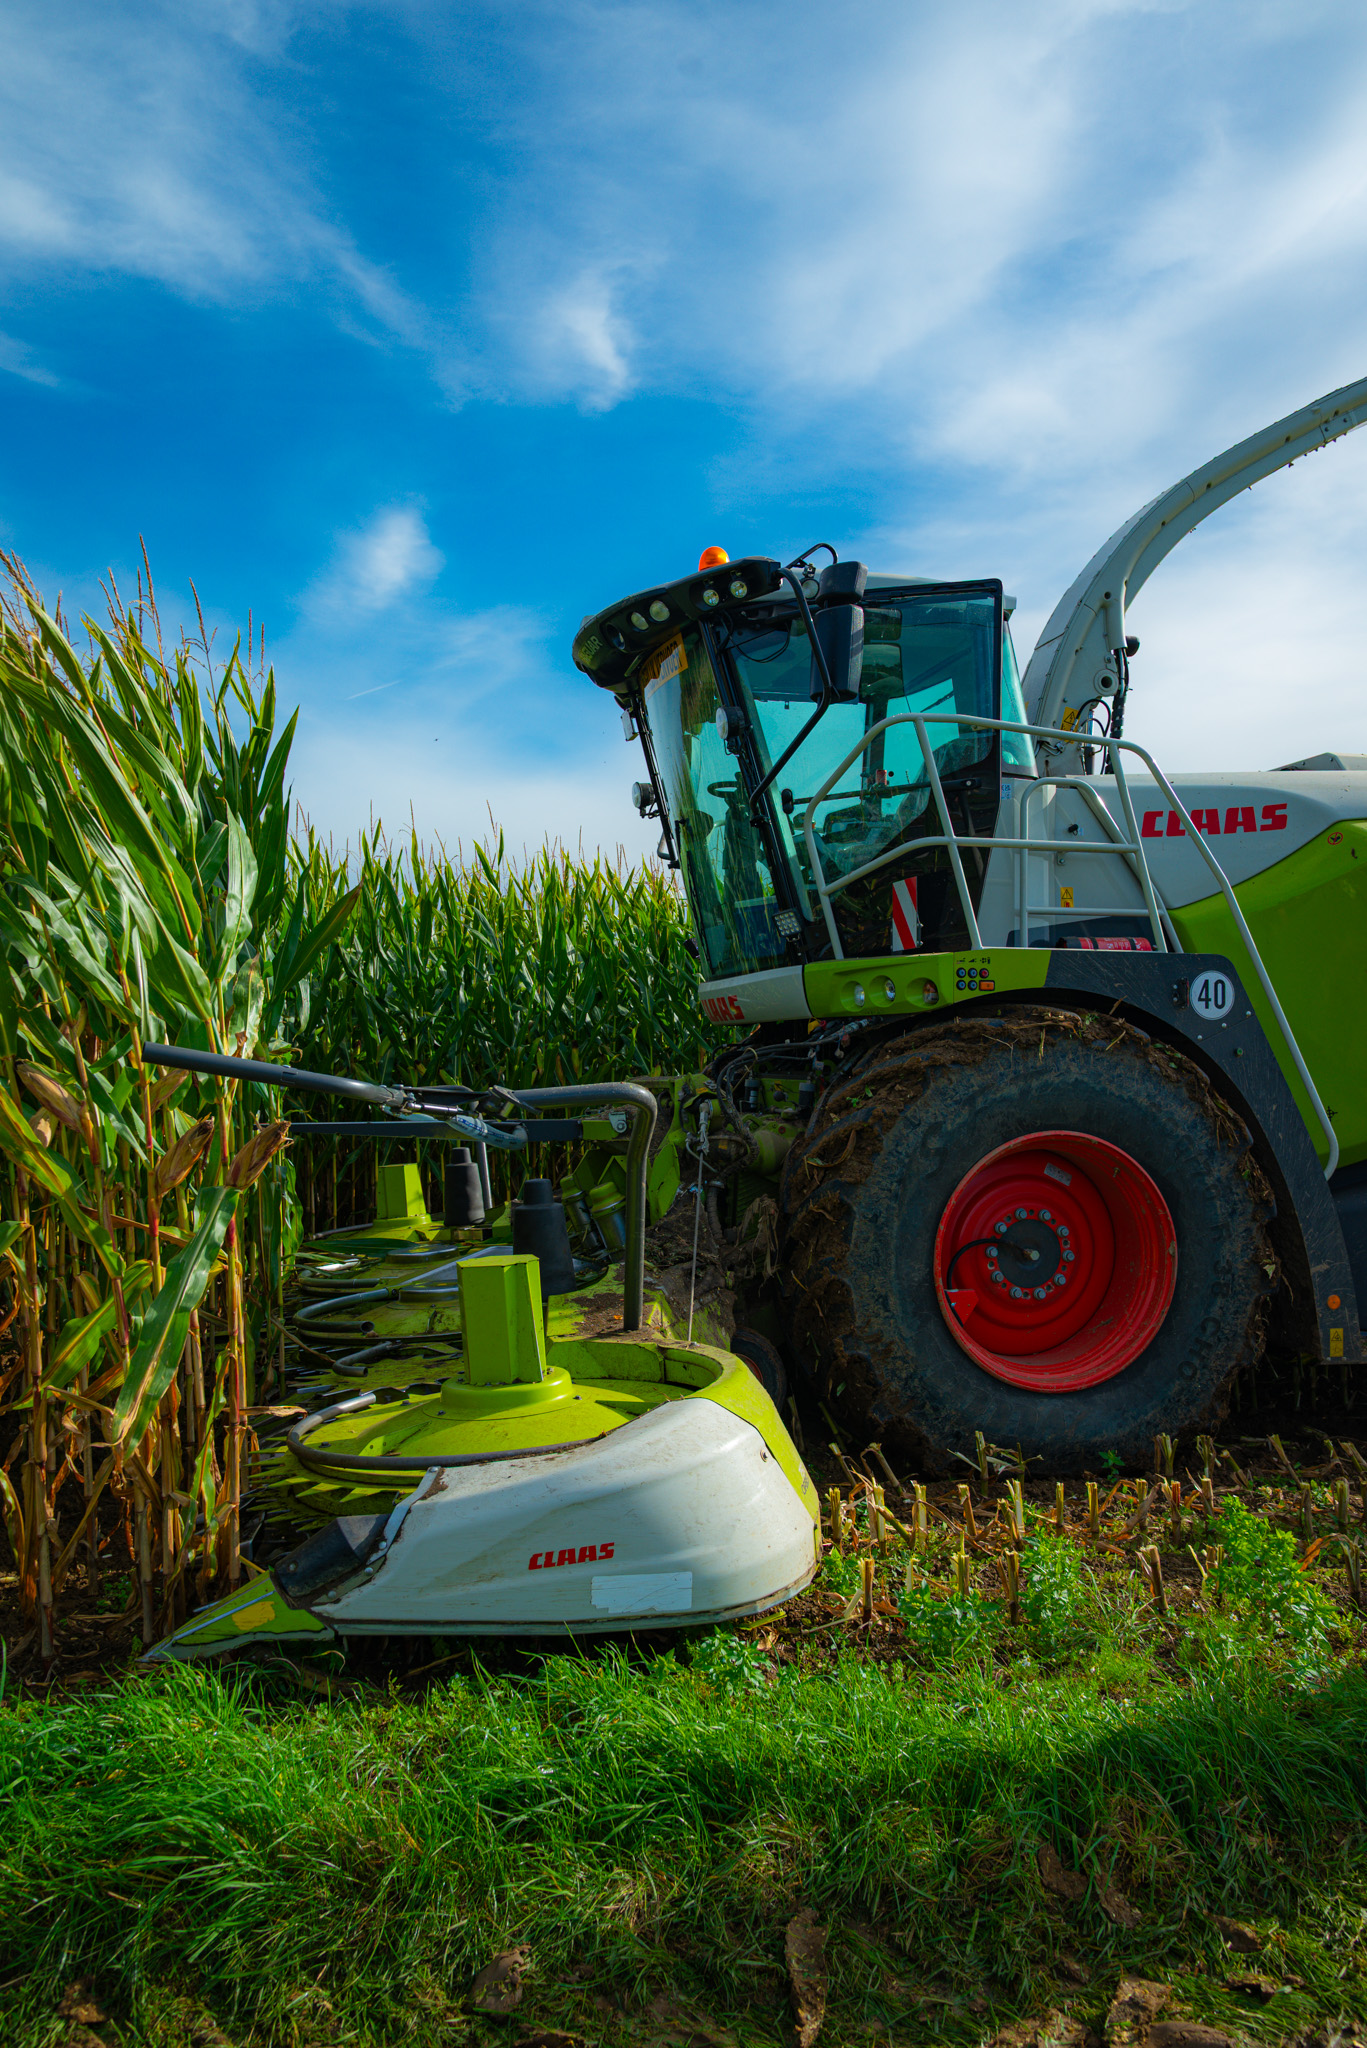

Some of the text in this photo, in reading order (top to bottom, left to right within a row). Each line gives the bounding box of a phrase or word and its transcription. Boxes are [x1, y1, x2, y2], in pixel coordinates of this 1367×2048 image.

[1141, 803, 1288, 838] CLAAS
[1198, 979, 1226, 1009] 40
[528, 1542, 615, 1570] CLAAS
